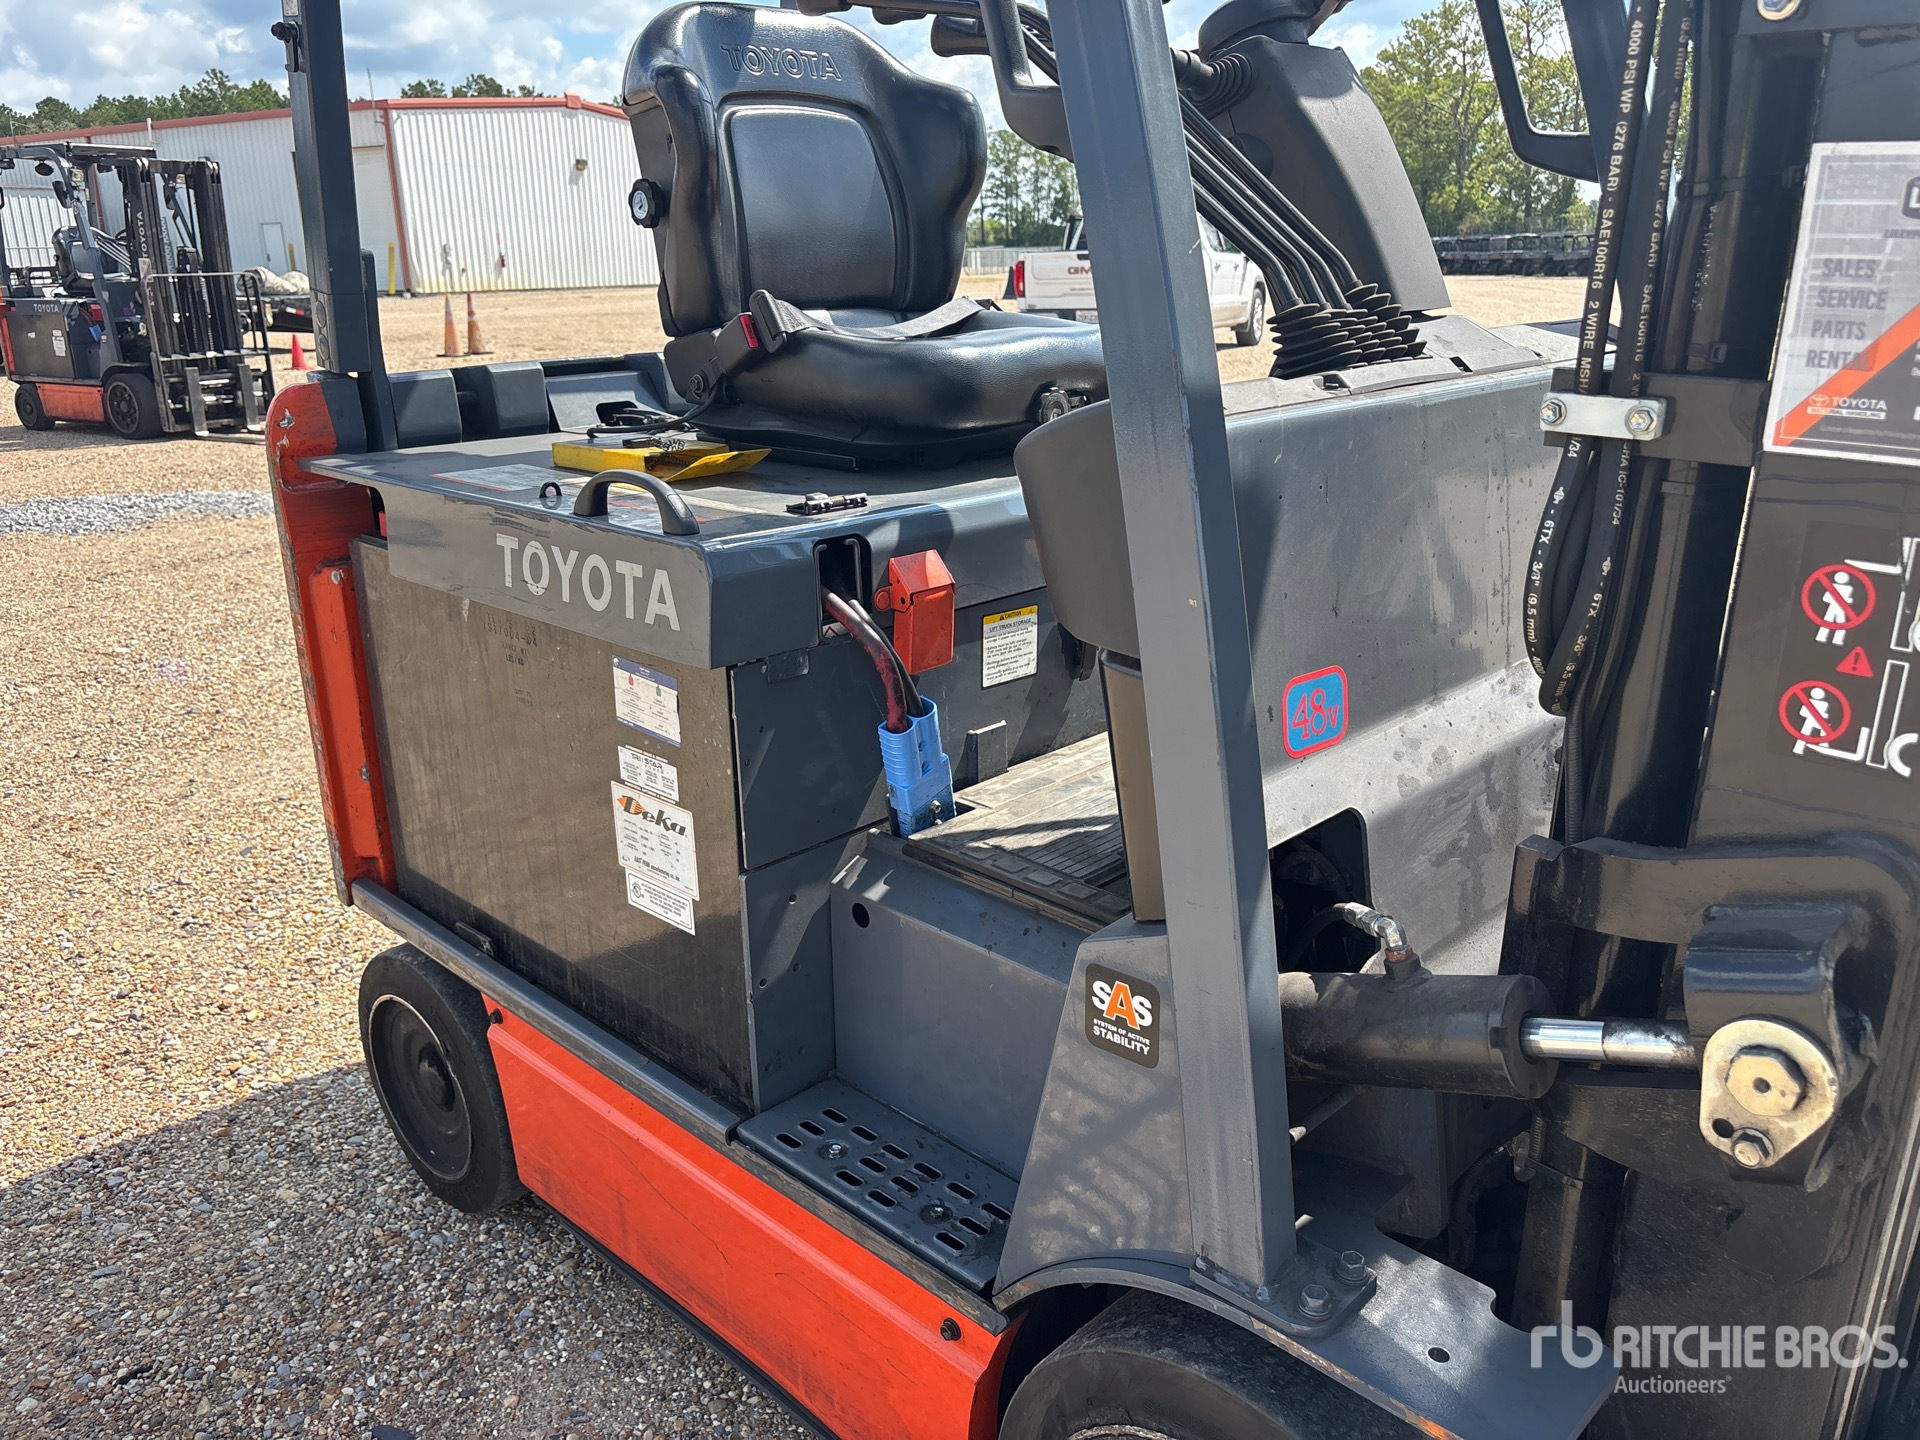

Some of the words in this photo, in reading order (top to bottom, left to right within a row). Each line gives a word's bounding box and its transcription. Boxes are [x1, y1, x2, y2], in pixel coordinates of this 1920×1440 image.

[1627, 19, 1645, 56] 4000
[720, 44, 842, 82] TOYOTA
[1623, 58, 1638, 85] PSI
[1619, 87, 1635, 114] WP
[1612, 120, 1629, 152] (276
[1606, 154, 1624, 193] BAR)
[136, 211, 148, 259] TOYOTA
[1591, 208, 1615, 290] SAE100R16
[1067, 266, 1092, 275] GM
[1822, 258, 1877, 279] SALES
[33, 303, 60, 313] TOYOTA
[1588, 300, 1600, 309] 2
[1815, 288, 1889, 311] SERVICE
[1582, 312, 1599, 350] WIRE
[1810, 319, 1868, 341] PARTS
[1831, 396, 1888, 411] TOYOTA
[1538, 519, 1555, 545] 6TX
[495, 532, 681, 632] TOYOTA
[1004, 611, 1022, 619] CAUTION
[1526, 592, 1539, 616] (9.5
[1587, 592, 1603, 618] 6TX
[1526, 618, 1538, 643] mm)
[617, 794, 687, 837] Deka
[1091, 980, 1153, 1031] SAS
[1092, 1025, 1150, 1056] STABILITY
[1093, 1018, 1118, 1033] SYSTEM
[1117, 1028, 1127, 1036] OF
[1127, 1031, 1150, 1046] ACTIVE
